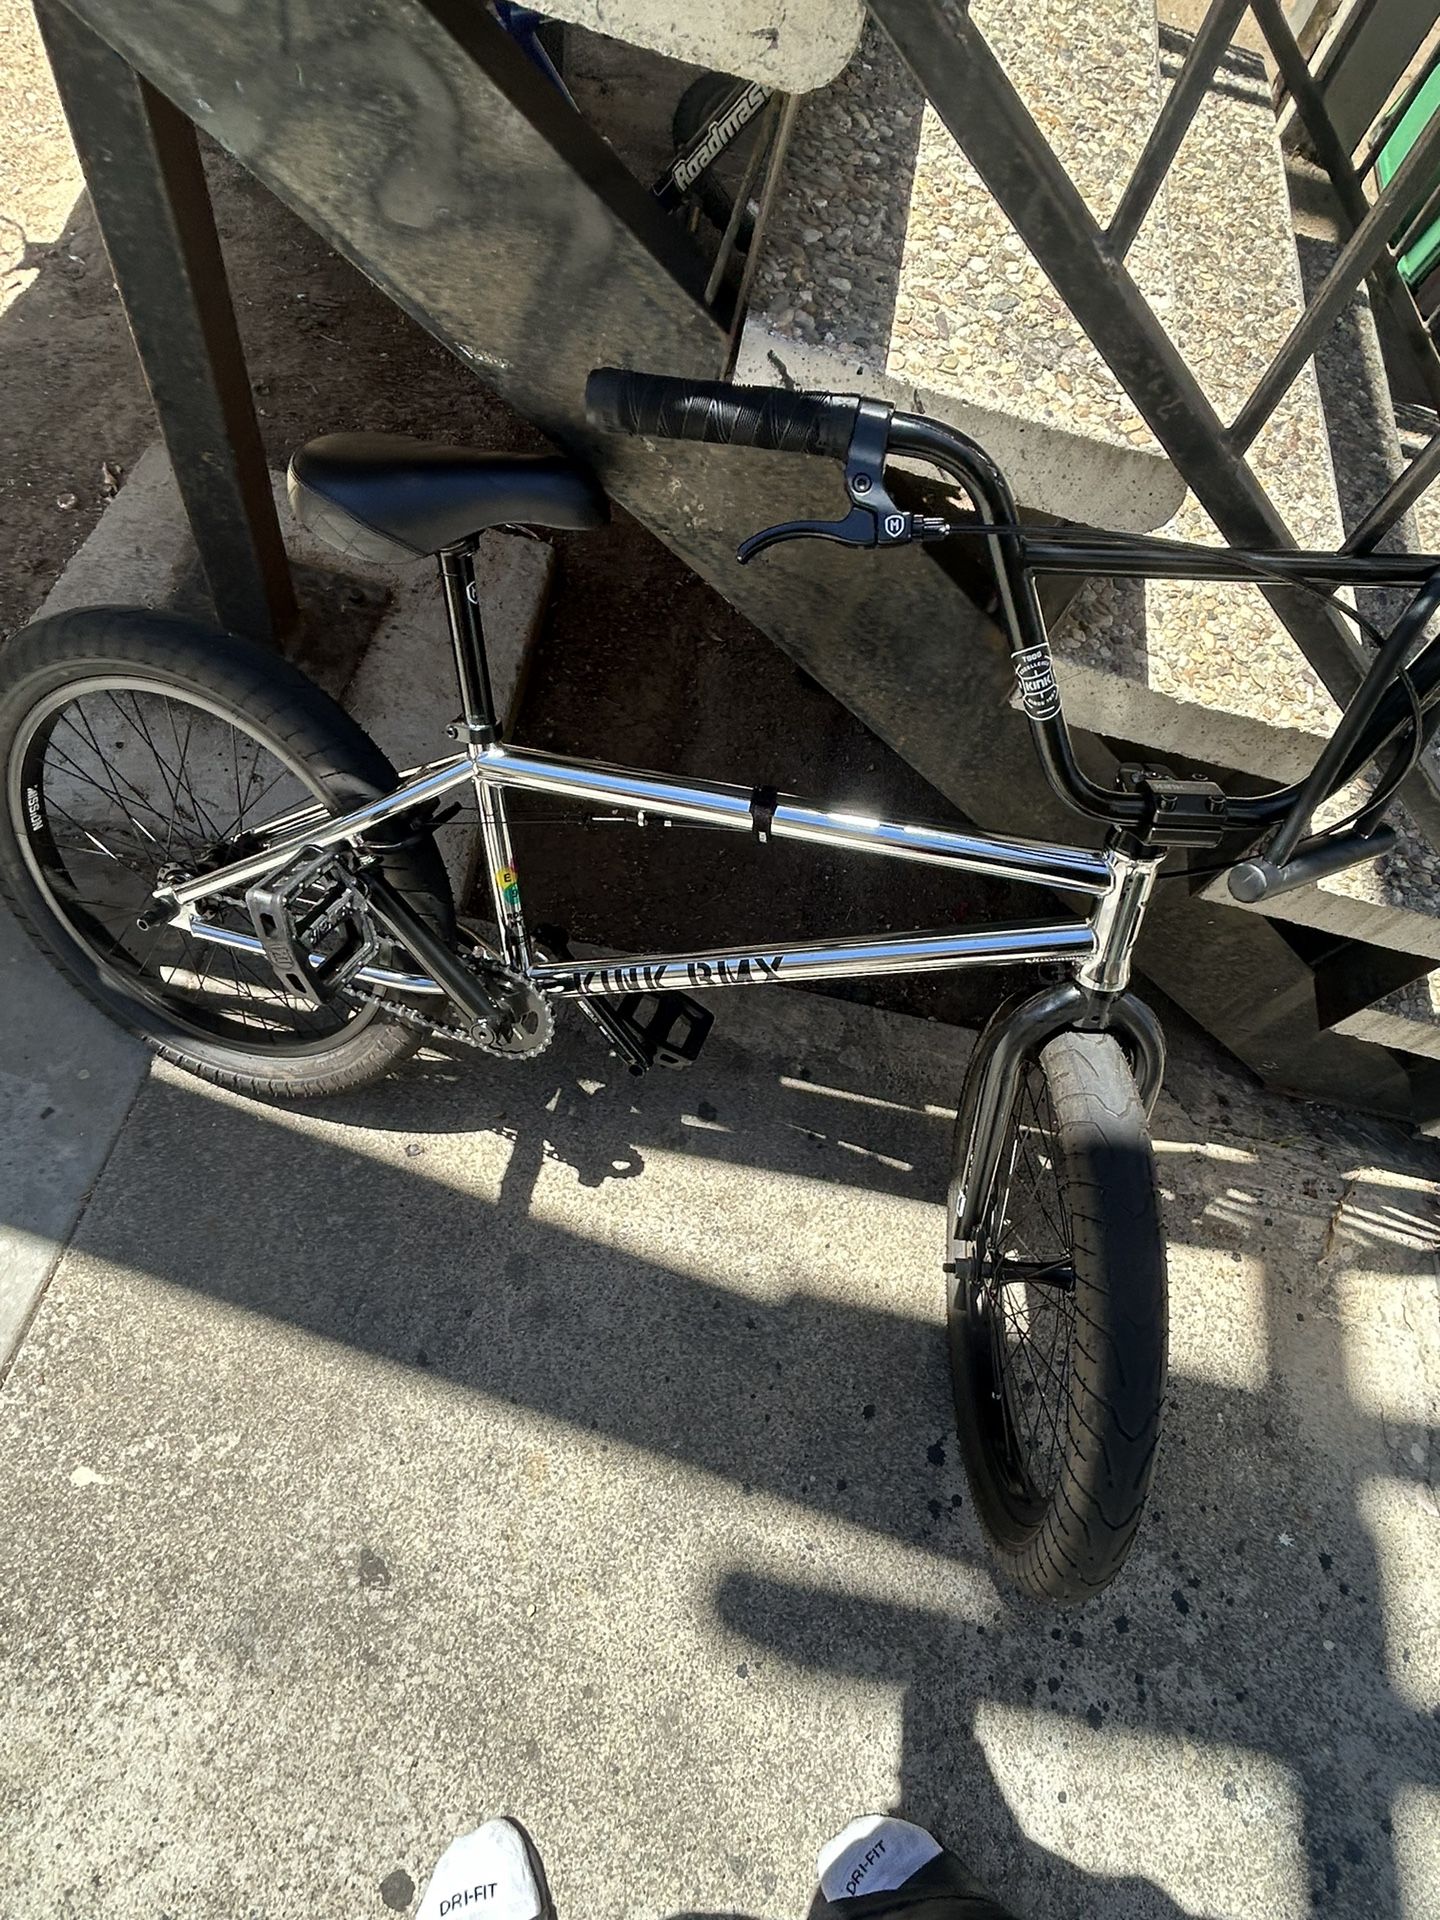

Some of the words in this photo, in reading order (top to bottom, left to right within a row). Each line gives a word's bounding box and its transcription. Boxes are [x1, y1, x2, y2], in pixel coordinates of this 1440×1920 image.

[27, 787, 44, 831] MISSION
[573, 965, 668, 994] KINK
[846, 1839, 887, 1896] DRI-FIT
[440, 1882, 498, 1917] DRI-FIT
